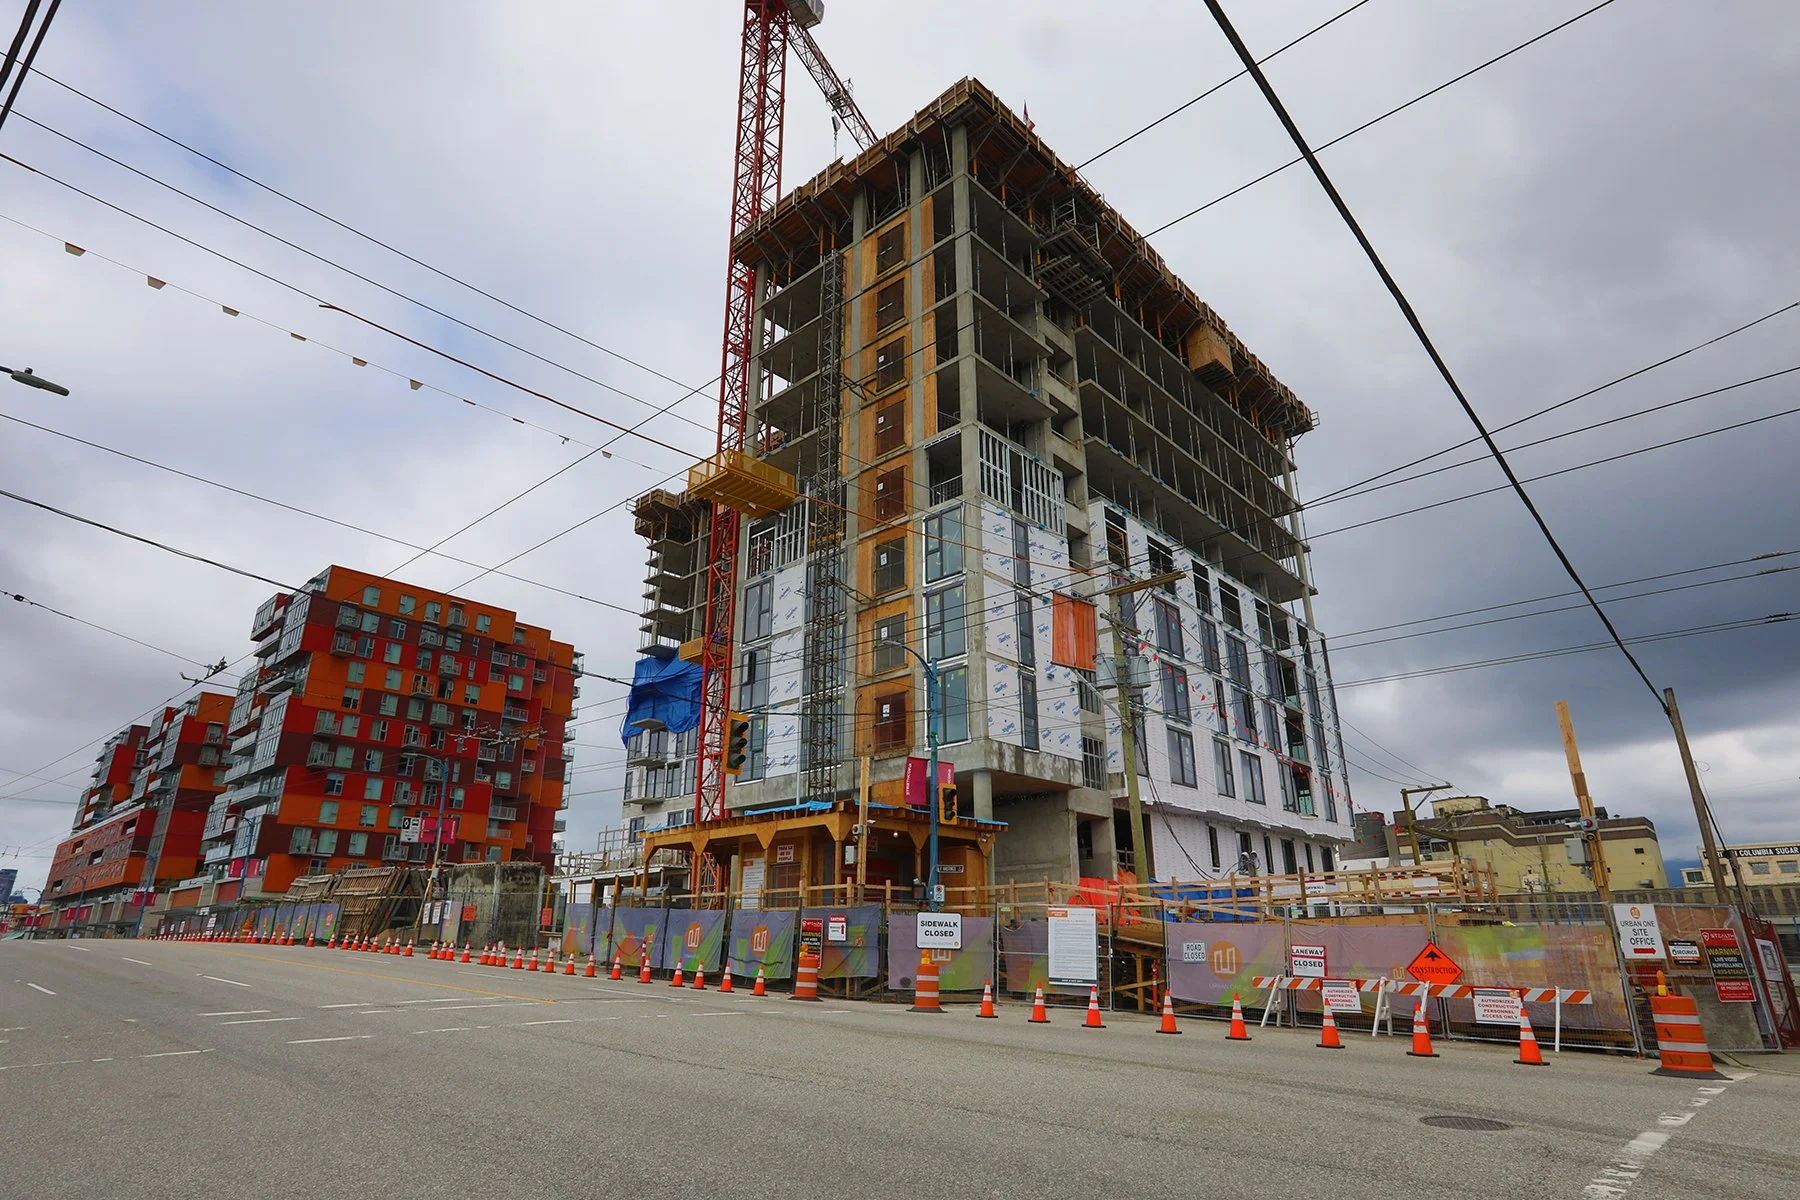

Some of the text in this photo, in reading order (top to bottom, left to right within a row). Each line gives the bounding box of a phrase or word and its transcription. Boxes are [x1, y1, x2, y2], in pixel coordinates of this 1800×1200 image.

[1740, 849, 1774, 857] COLUMBIA
[1776, 847, 1799, 855] SUGAR
[920, 920, 959, 928] SIDEWALK
[1620, 920, 1642, 928] URBAN
[1632, 928, 1648, 937] SITE
[1629, 937, 1656, 946] OFFICE
[1707, 948, 1741, 956] WARNING
[1293, 960, 1323, 968] CLOSED
[1410, 966, 1458, 975] CONSTRUCTION
